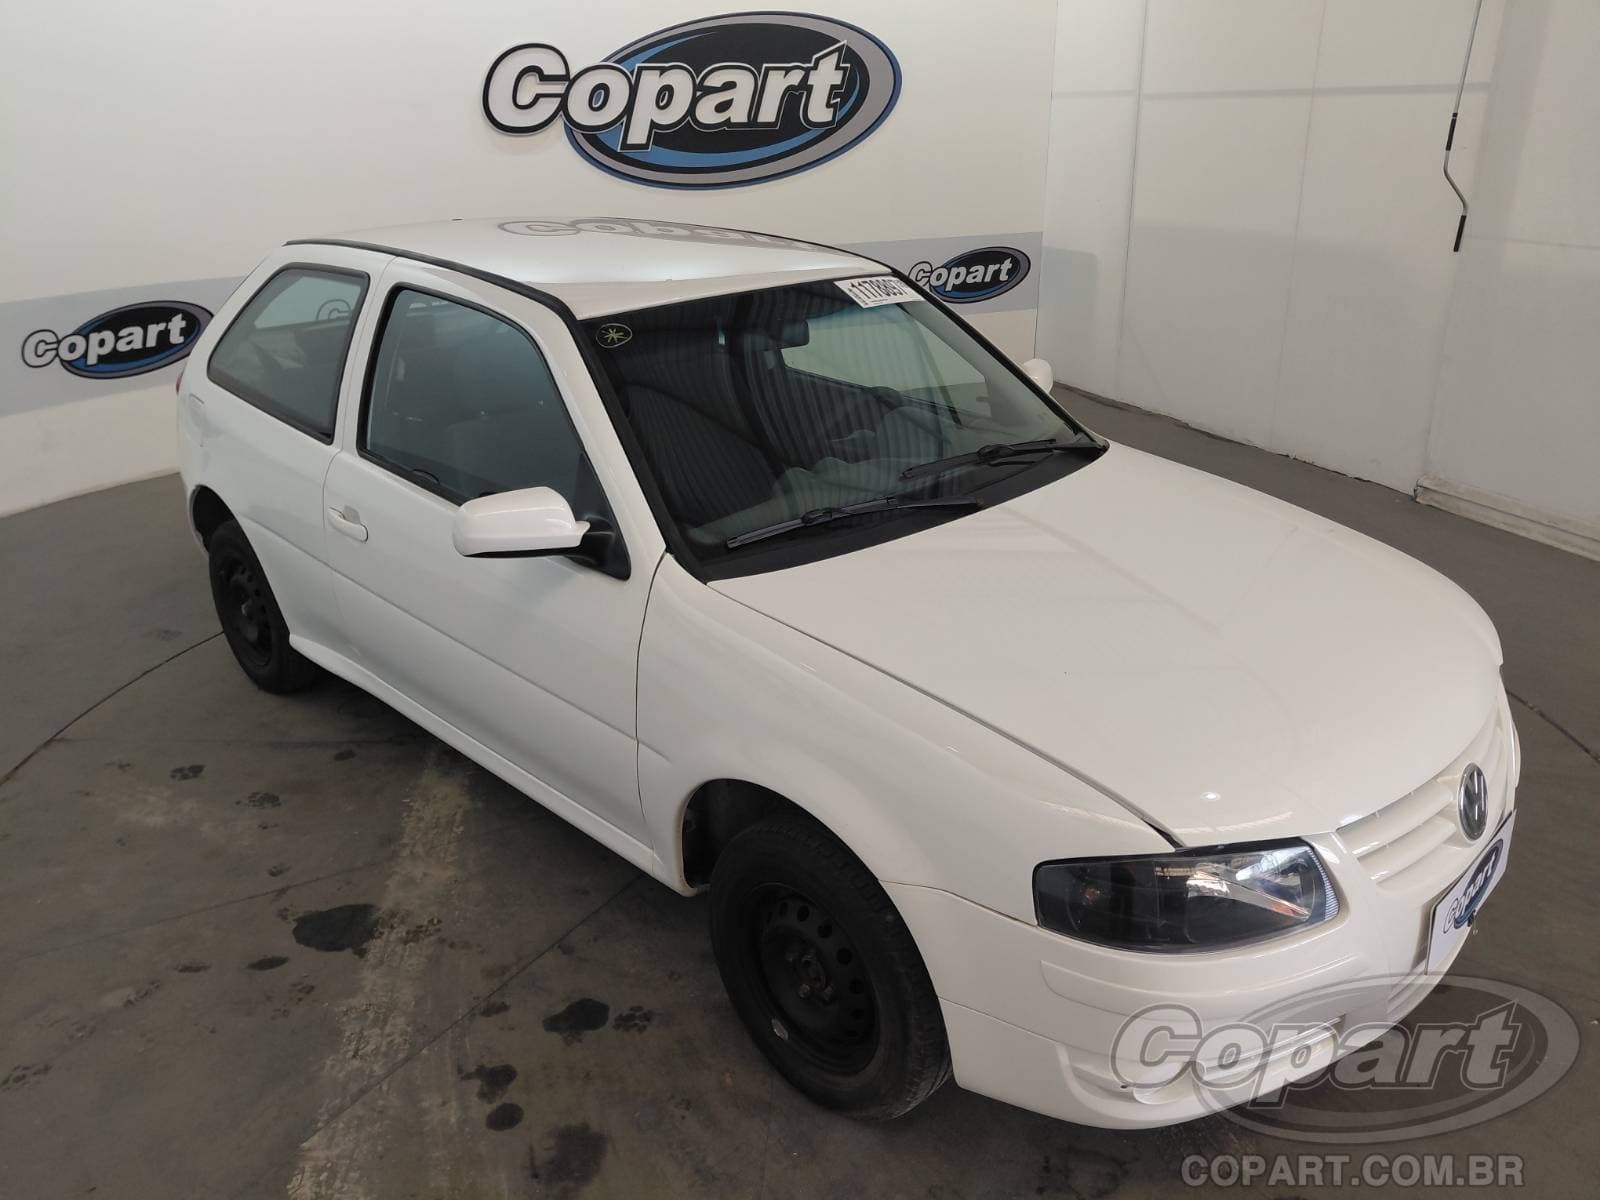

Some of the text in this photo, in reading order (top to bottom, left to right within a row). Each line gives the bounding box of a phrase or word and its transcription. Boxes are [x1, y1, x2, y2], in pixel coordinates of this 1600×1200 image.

[484, 42, 850, 151] Copart
[908, 257, 1014, 292] Copart
[22, 313, 188, 368] Copart
